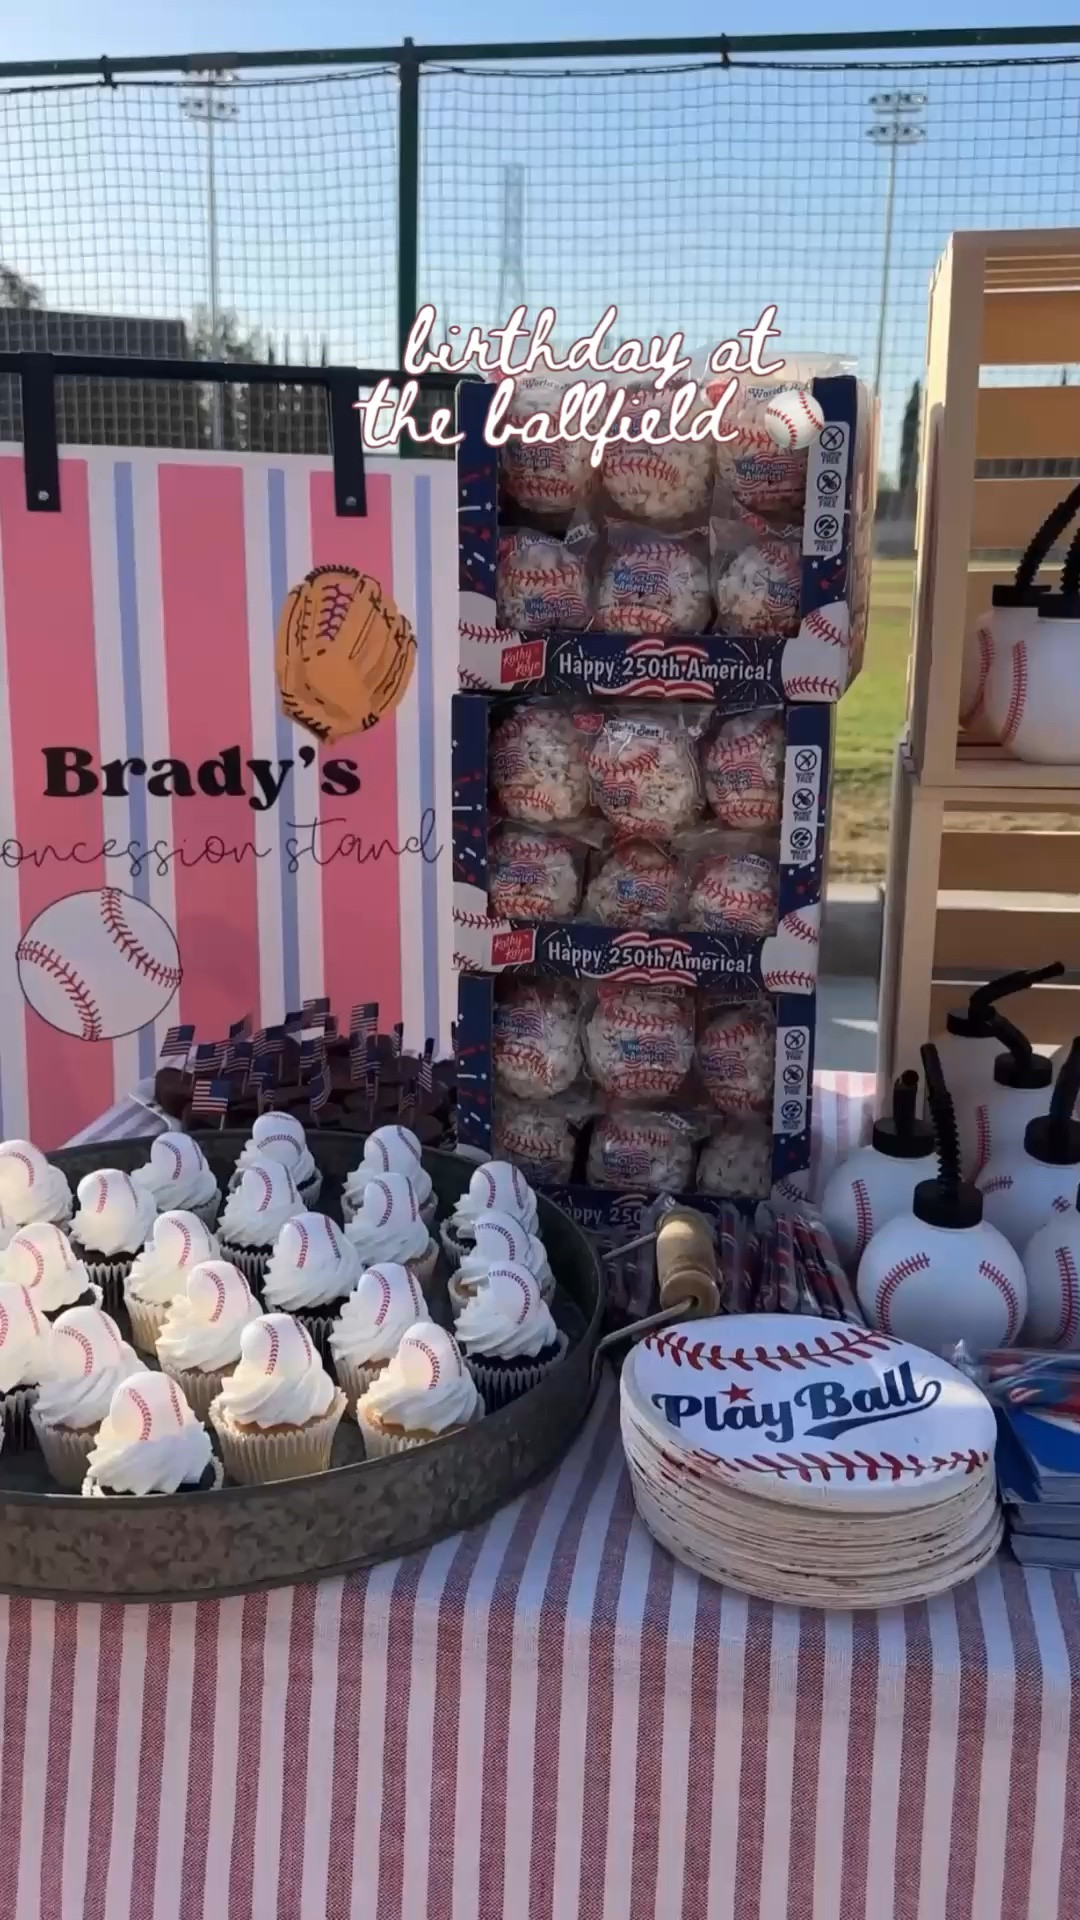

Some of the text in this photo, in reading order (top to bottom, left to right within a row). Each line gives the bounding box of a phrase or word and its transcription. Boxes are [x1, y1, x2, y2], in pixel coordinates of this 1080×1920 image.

[559, 652, 773, 681] Happy 250th America!
[42, 745, 361, 810] Brady's
[0, 808, 445, 877] oncession stand
[549, 941, 752, 973] Happy 250th America!
[566, 1206, 641, 1225] appy 250
[652, 1360, 941, 1443] Play Ball
